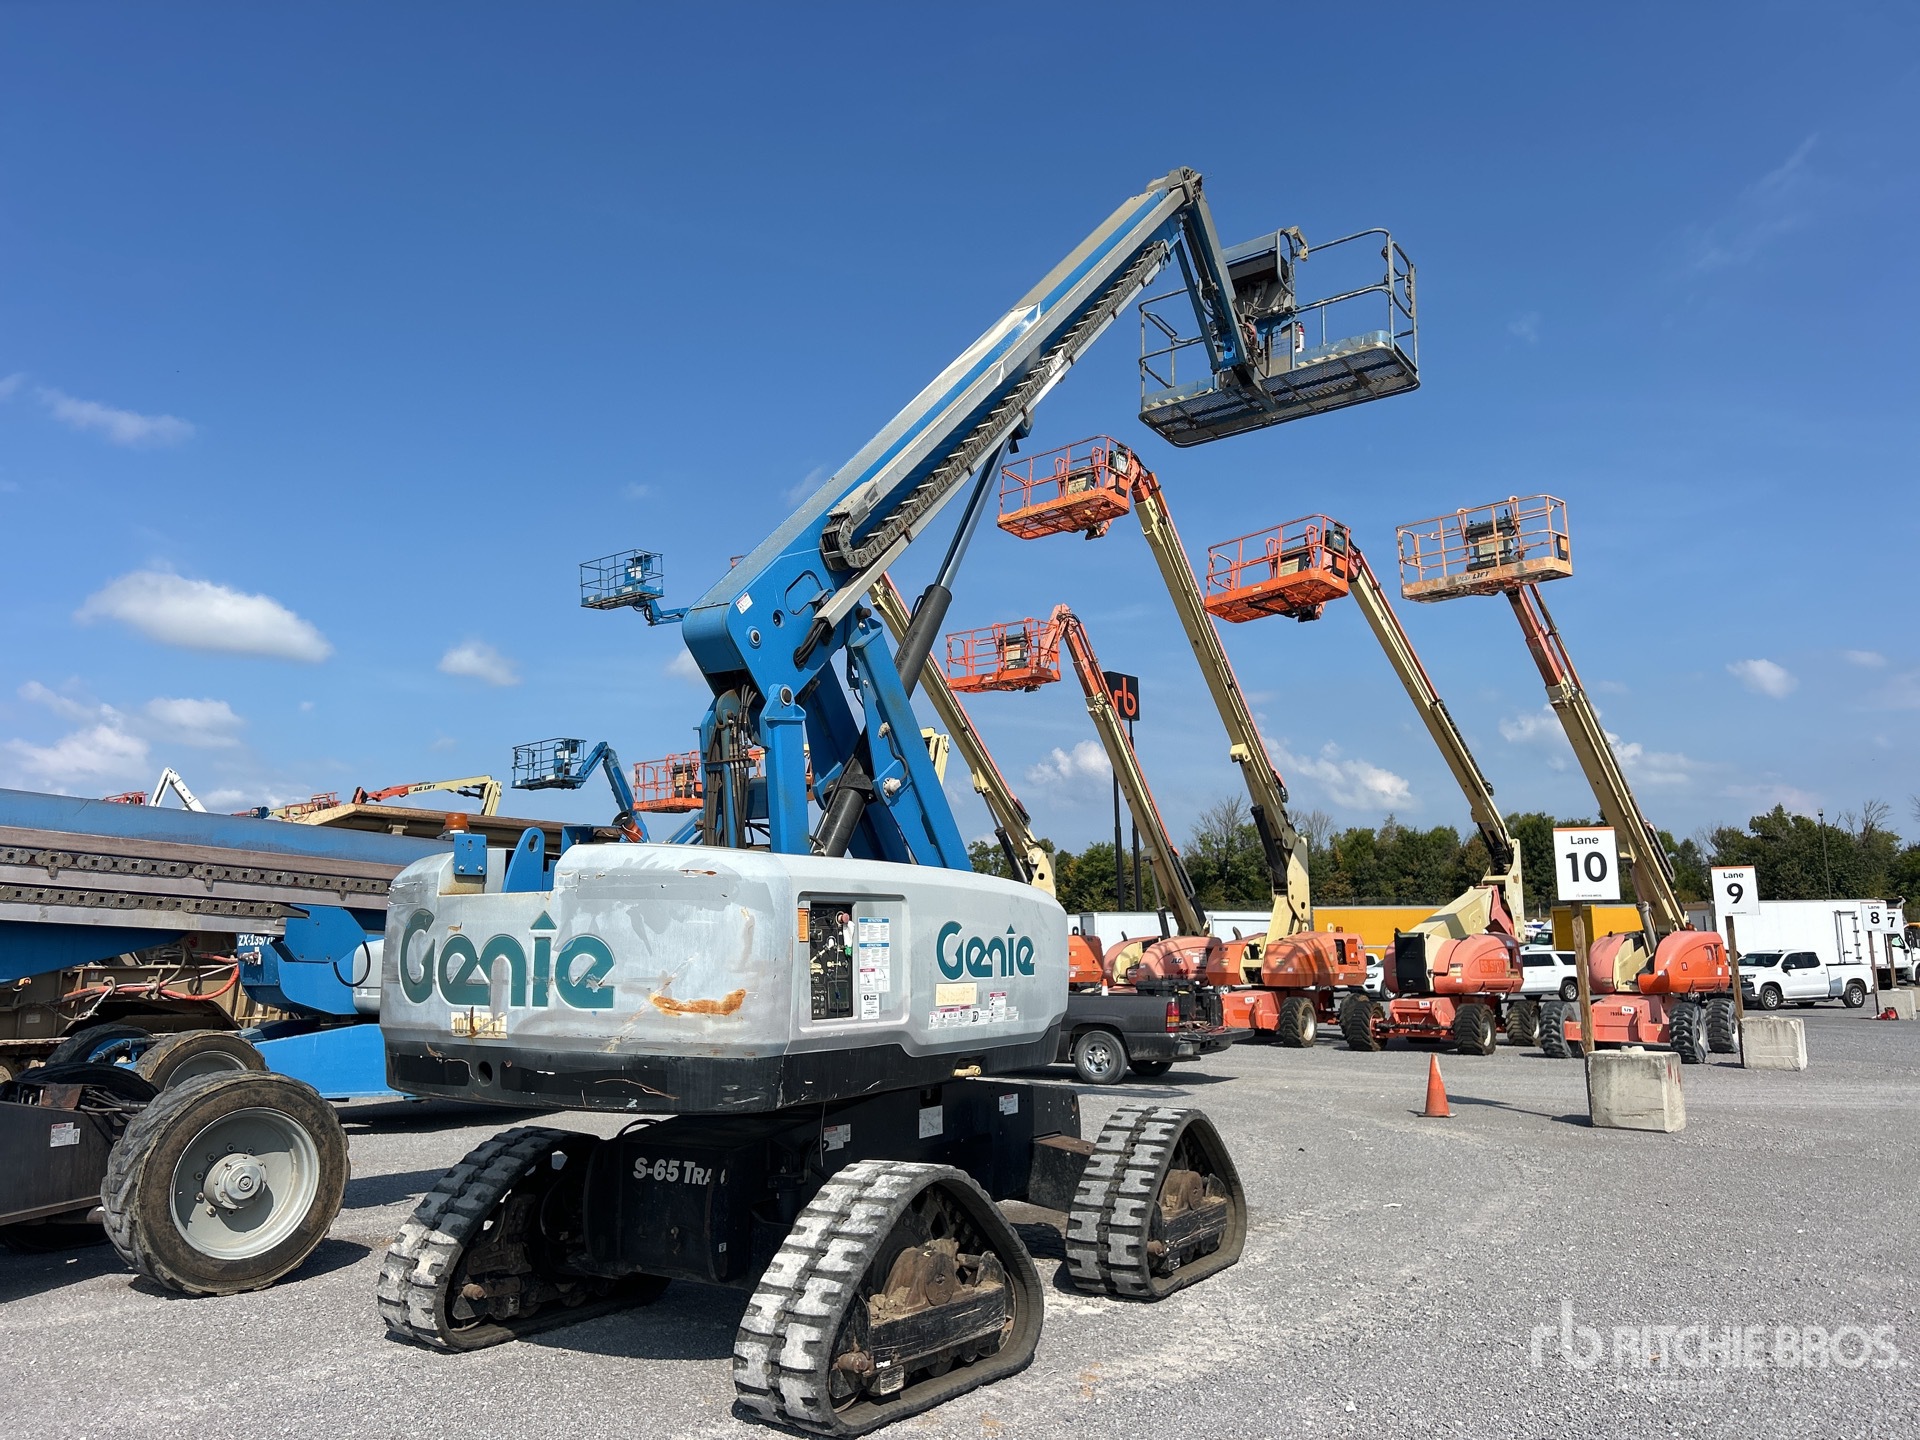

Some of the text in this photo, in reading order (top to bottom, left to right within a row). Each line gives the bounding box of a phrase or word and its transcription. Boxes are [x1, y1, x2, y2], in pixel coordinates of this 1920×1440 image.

[1114, 676, 1137, 716] rb
[1570, 835, 1599, 845] Lane
[1565, 851, 1608, 882] 10
[1723, 871, 1744, 879] Lane
[1726, 882, 1744, 904] 9
[1870, 911, 1881, 924] 8
[1887, 916, 1896, 928] 7
[400, 909, 615, 1009] Genie
[936, 920, 1036, 980] Genie
[633, 1157, 680, 1182] S-65
